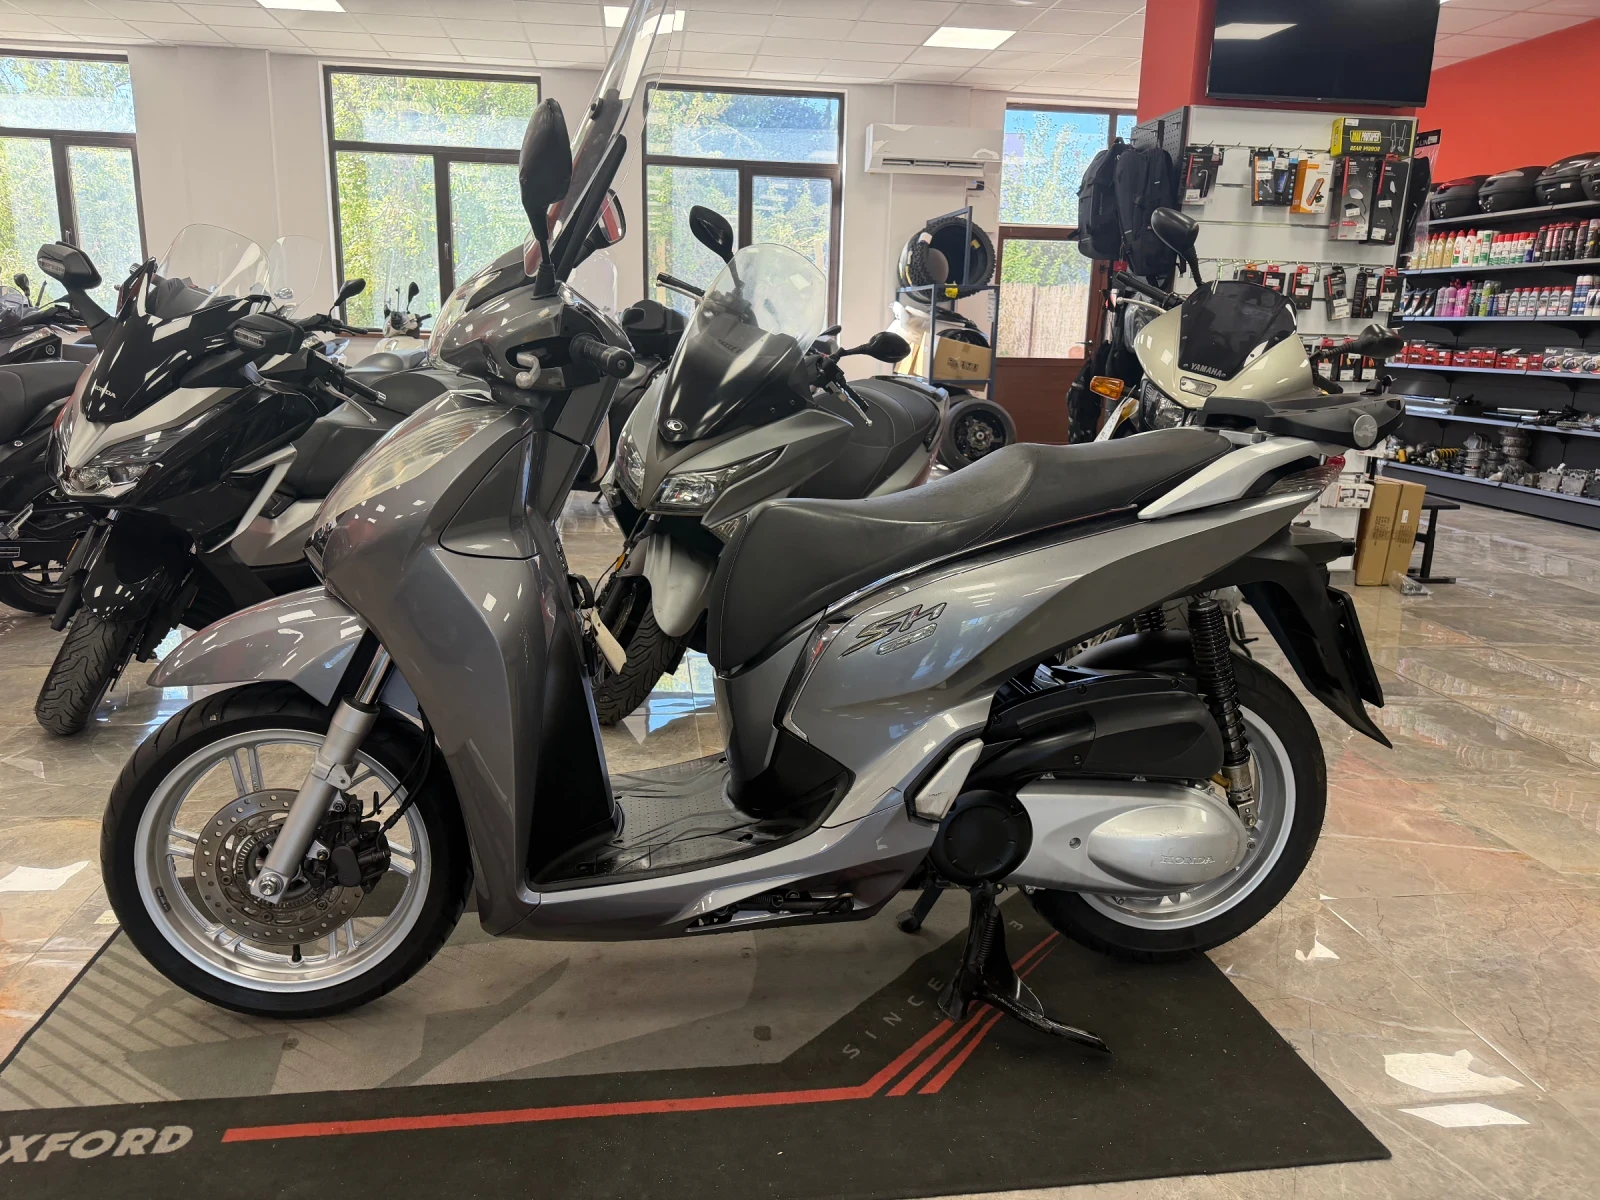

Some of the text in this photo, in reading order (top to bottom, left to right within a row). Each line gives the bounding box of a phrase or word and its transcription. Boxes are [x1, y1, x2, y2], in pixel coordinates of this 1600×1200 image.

[1190, 362, 1223, 377] YAMAHA
[1159, 854, 1216, 865] HONDA
[841, 976, 944, 1060] SINCE
[0, 1125, 194, 1165] XFORD
